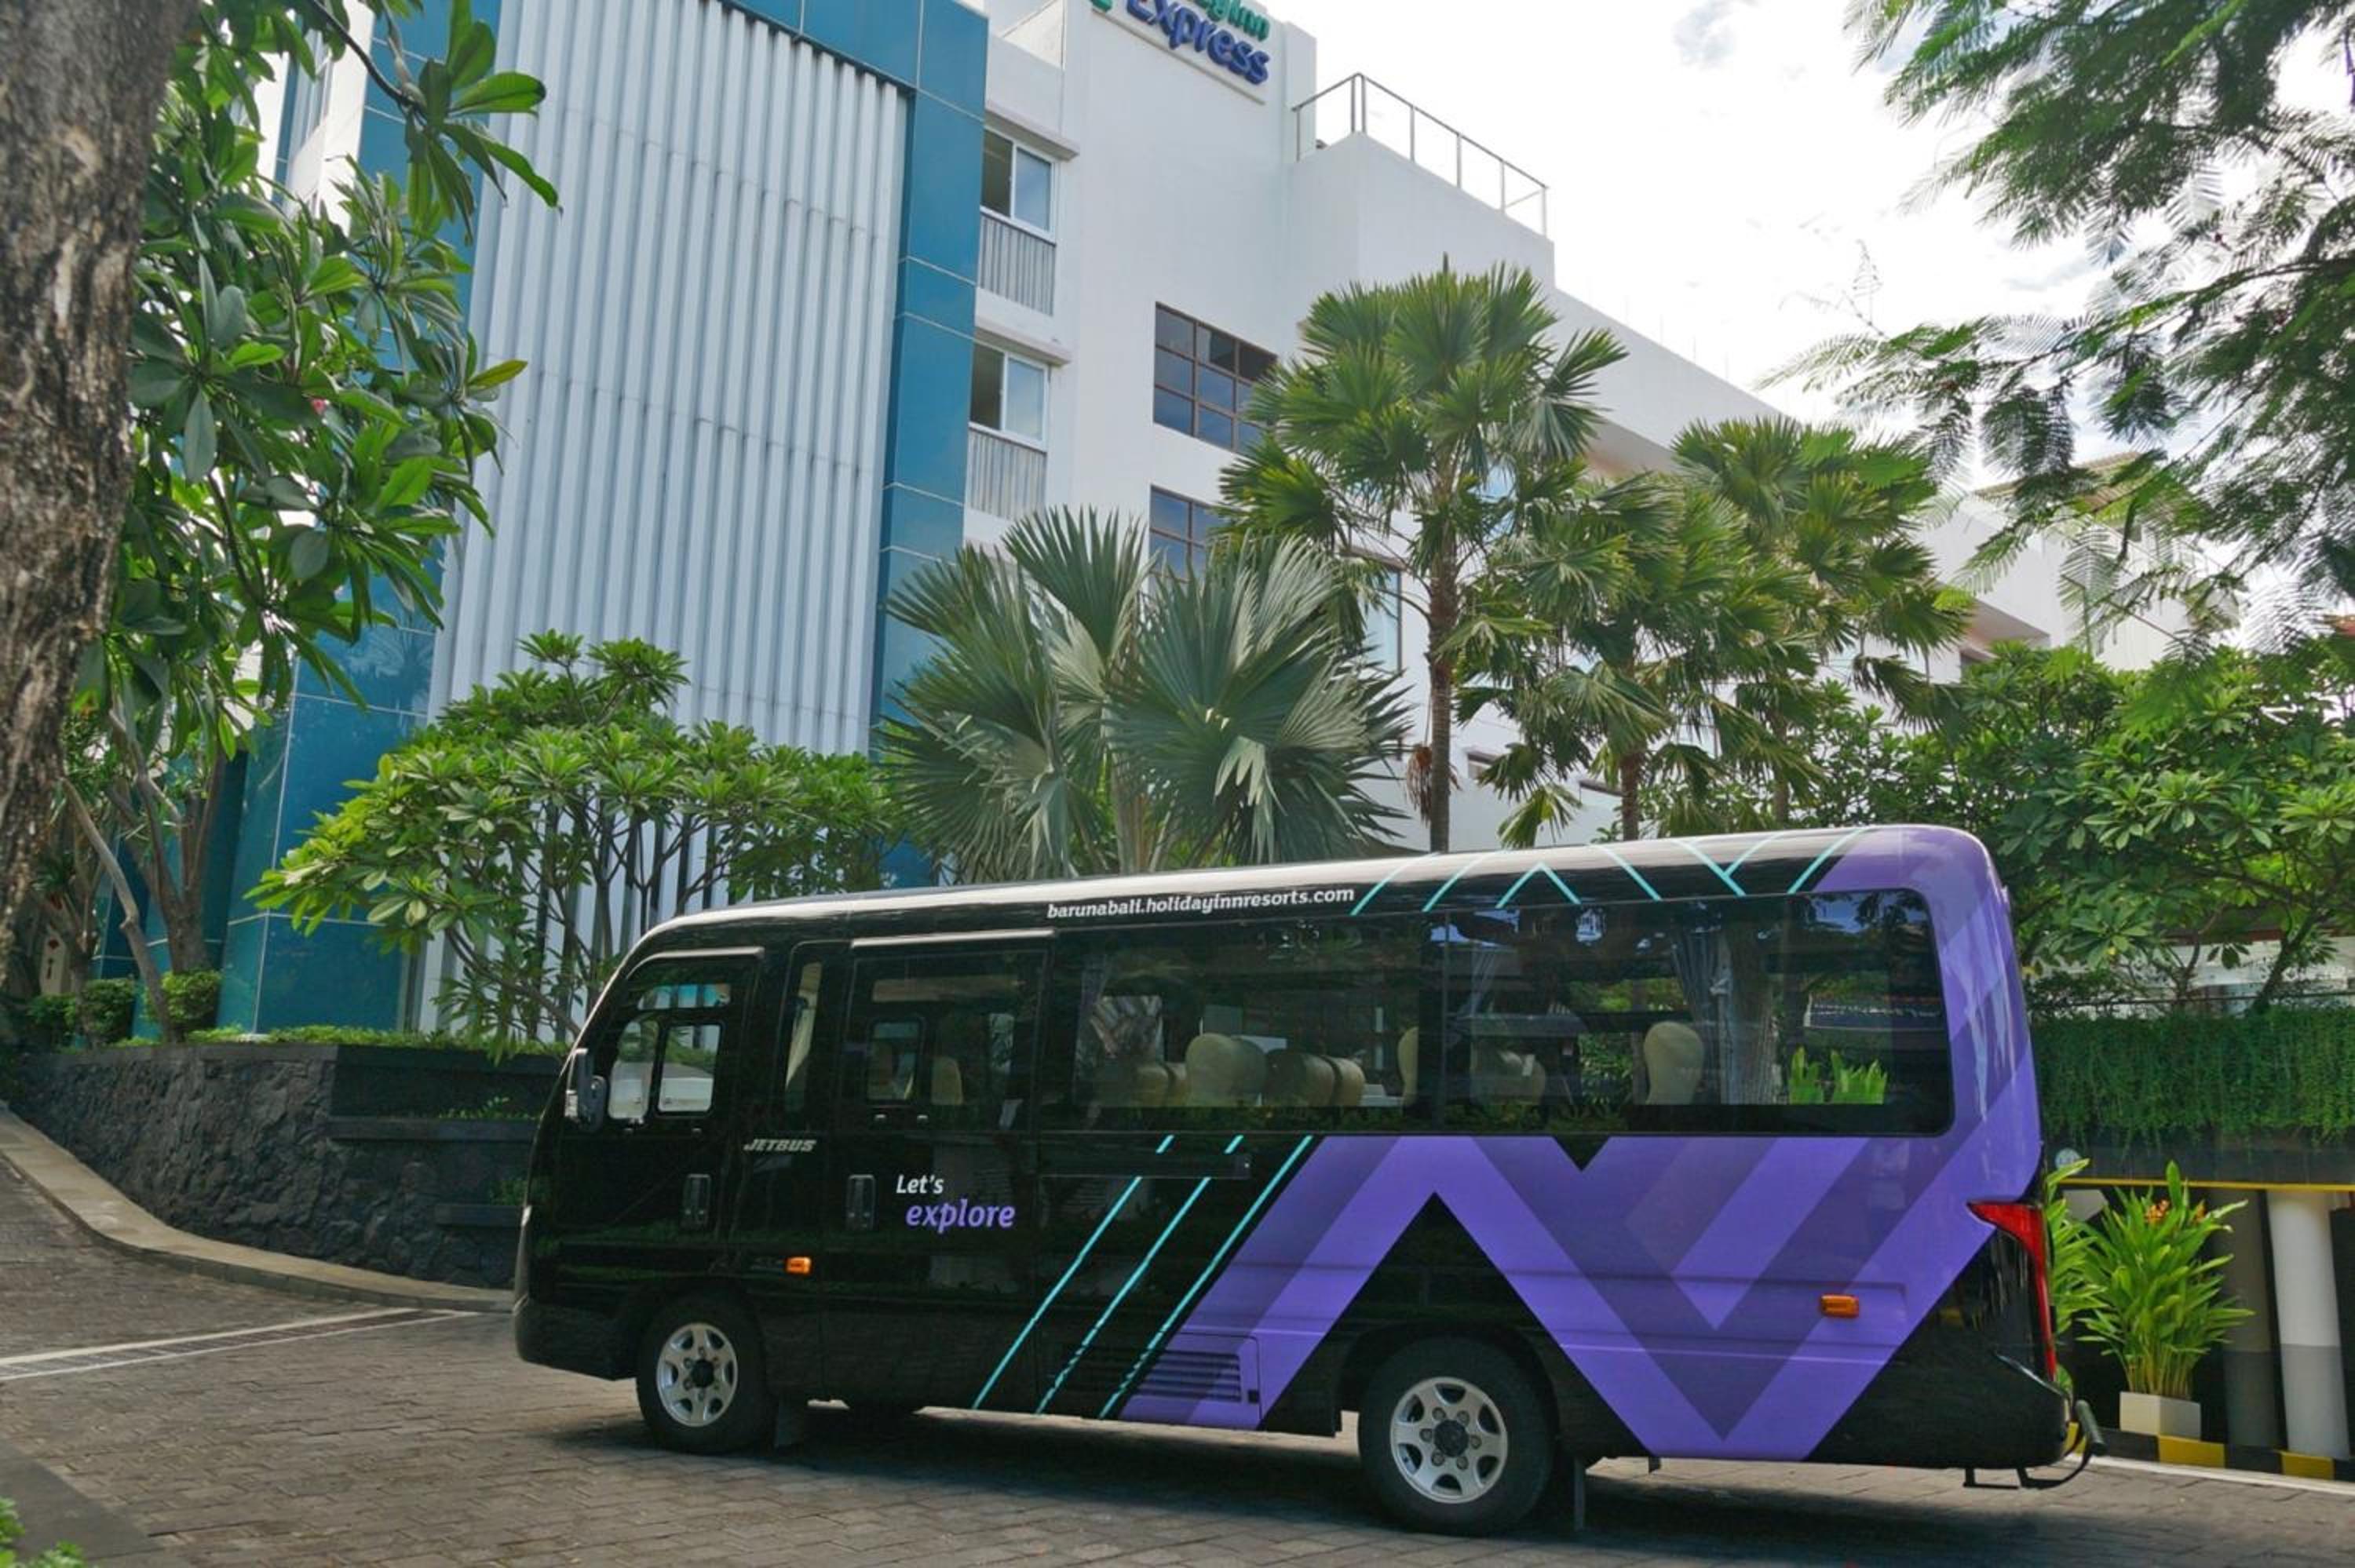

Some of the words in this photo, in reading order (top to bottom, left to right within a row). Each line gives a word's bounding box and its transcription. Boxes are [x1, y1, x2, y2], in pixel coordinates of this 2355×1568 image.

[1046, 888, 1355, 919] barunabali.holidayinnresorts.com
[743, 1138, 816, 1152] JETBUS
[896, 1175, 944, 1194] Let's
[905, 1198, 1016, 1234] explore
